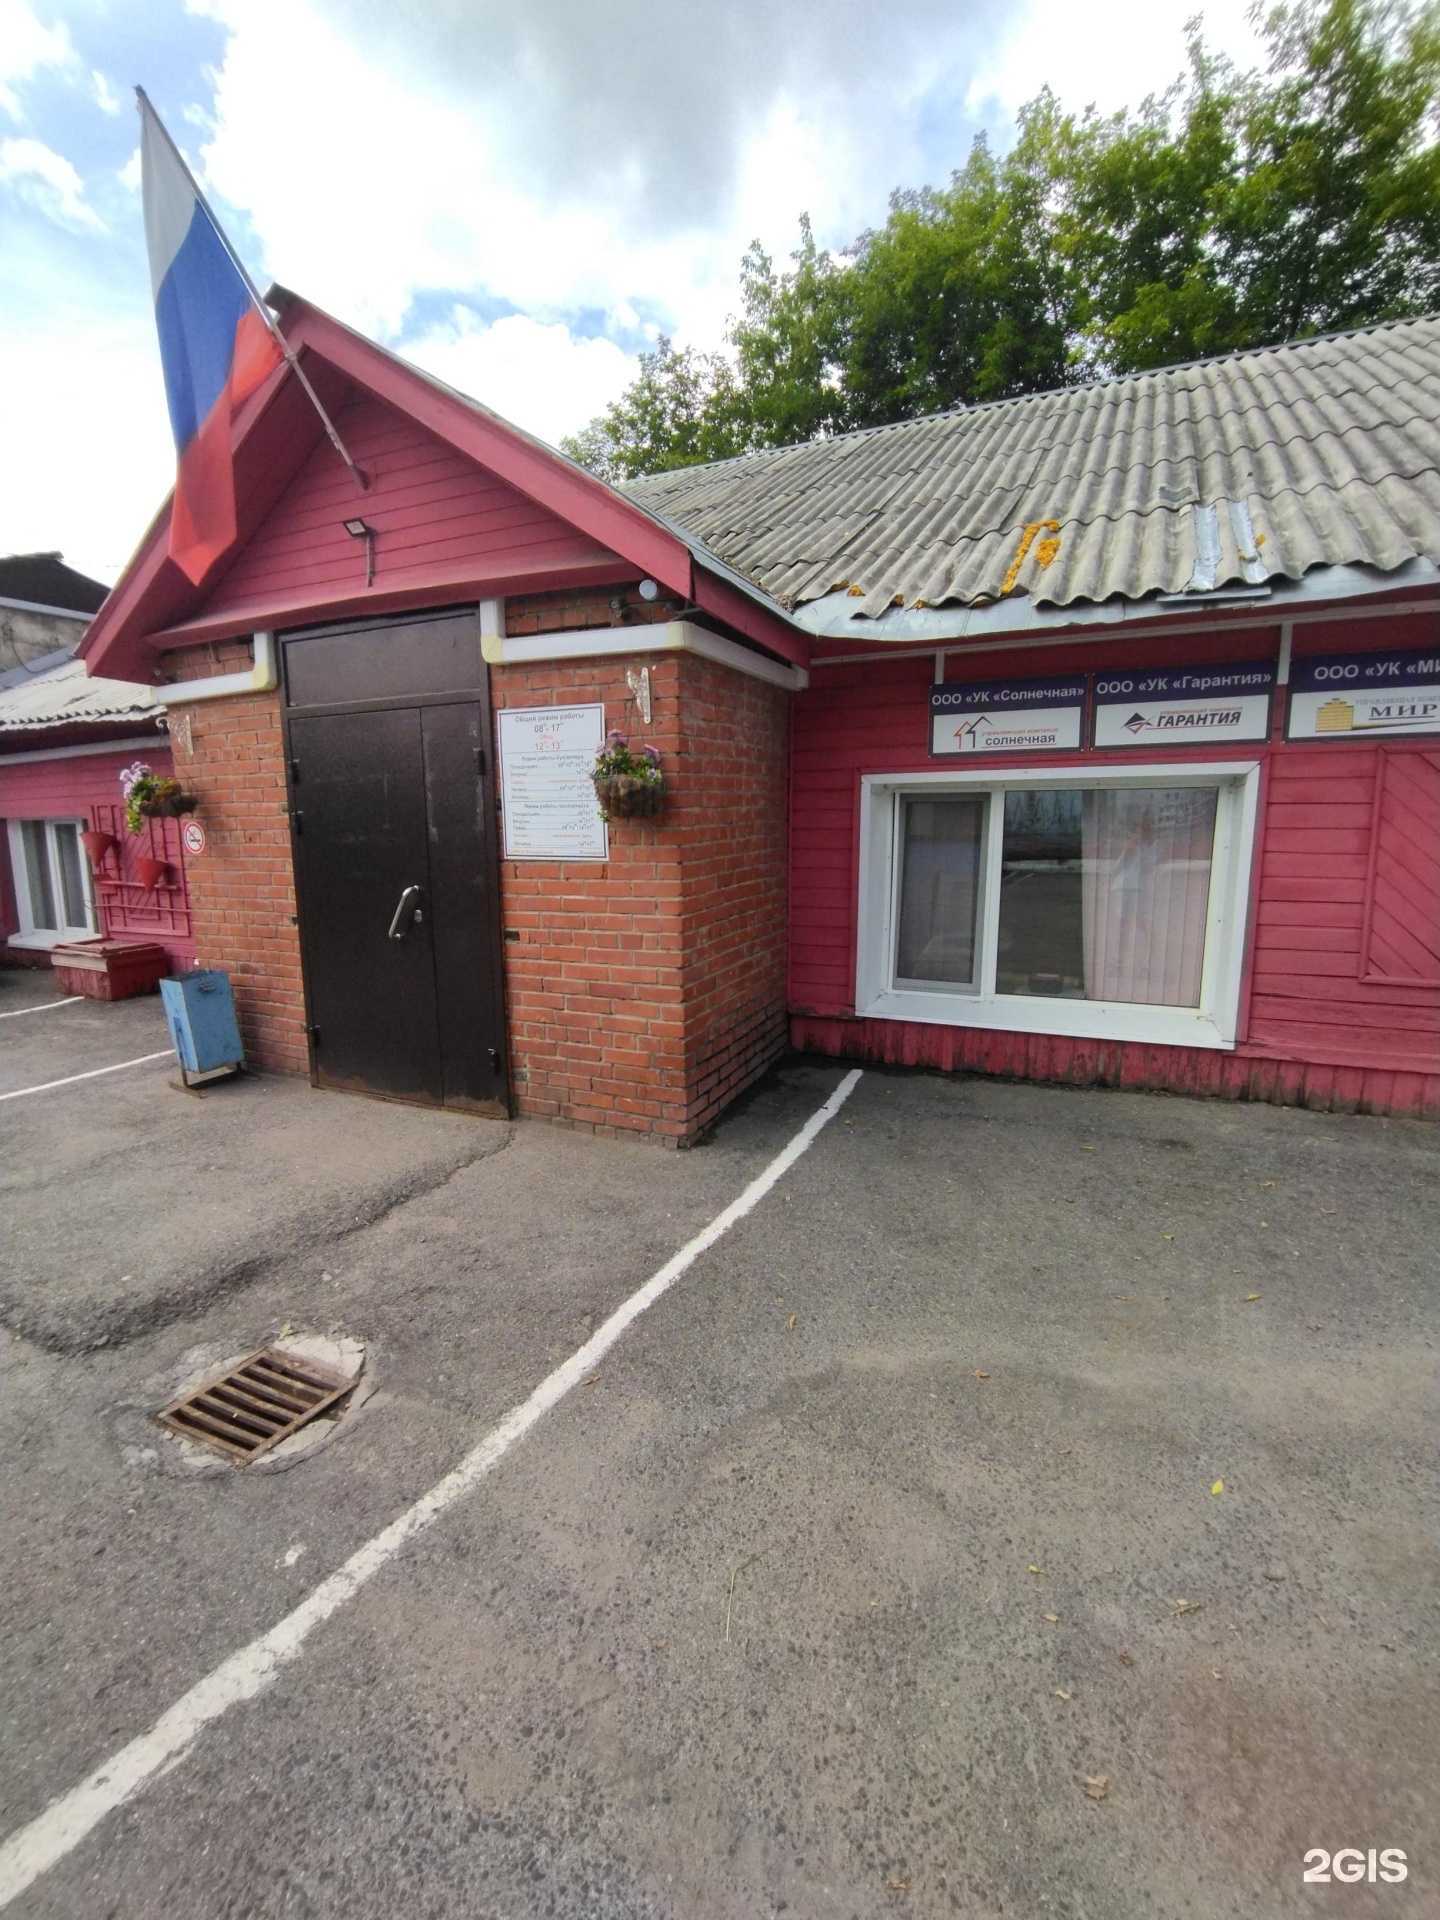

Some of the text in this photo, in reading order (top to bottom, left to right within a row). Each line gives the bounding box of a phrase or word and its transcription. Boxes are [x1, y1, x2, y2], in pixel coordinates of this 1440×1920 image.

[1314, 664, 1359, 680] ООО
[1365, 662, 1400, 676] «УК
[1096, 673, 1272, 694] ООО «УК «Гарантия»
[932, 687, 1085, 706] ООО «УК «Солнечная»
[1157, 711, 1242, 727] ГАРАНТИЯ
[1370, 704, 1438, 717] МИР
[985, 733, 1057, 746] солнечная
